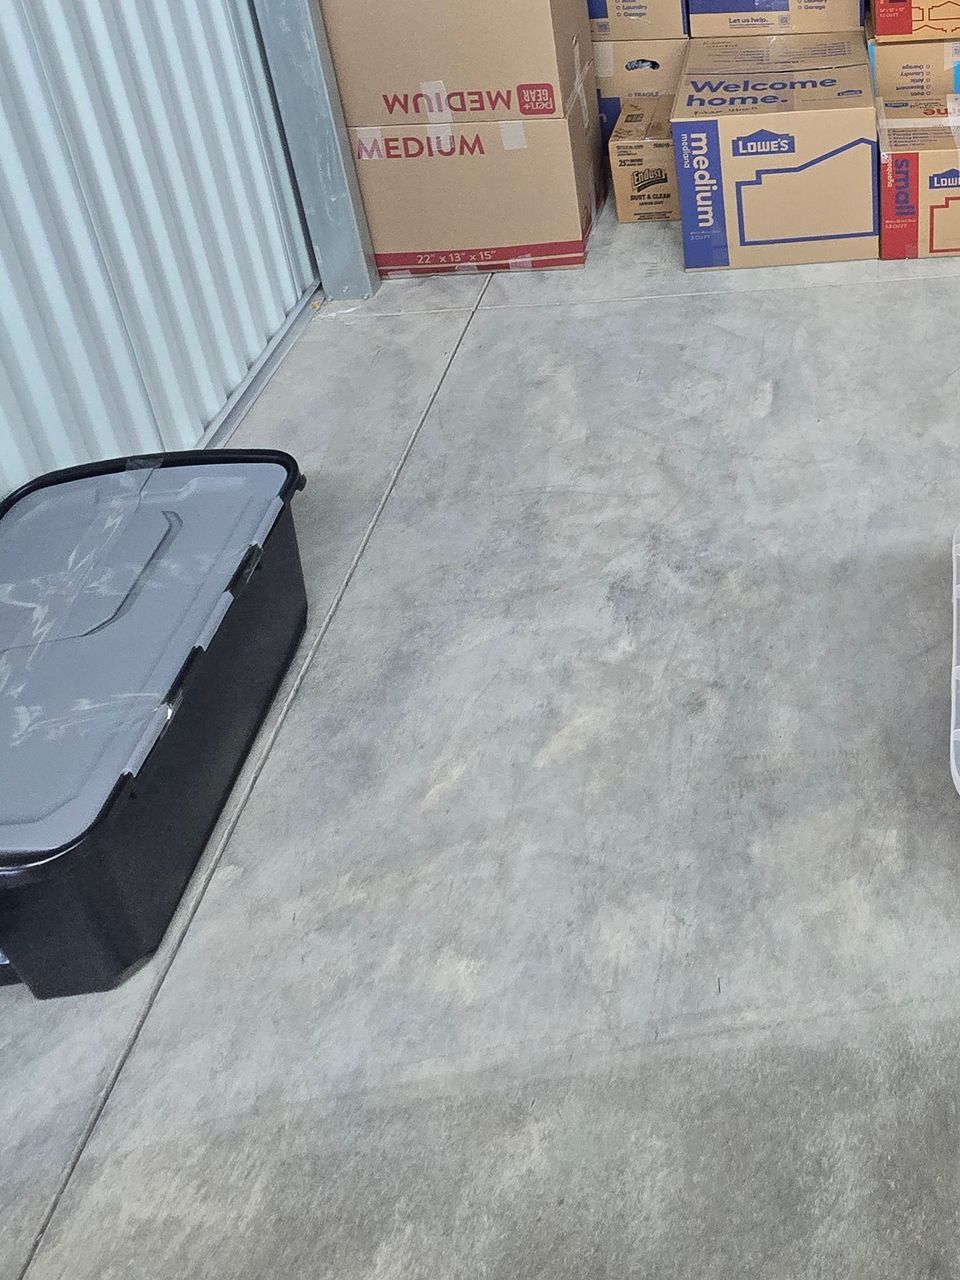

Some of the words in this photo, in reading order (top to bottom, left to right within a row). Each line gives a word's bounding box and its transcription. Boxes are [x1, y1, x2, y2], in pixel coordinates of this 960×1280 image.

[690, 78, 837, 93] Welcome
[382, 89, 511, 115] MEDIUM
[522, 88, 549, 101] GEAR
[686, 95, 788, 107] home.
[523, 99, 553, 110] pen+
[357, 133, 485, 159] MEDIUM
[681, 133, 691, 169] mediana
[739, 138, 789, 154] LOWE'S
[691, 132, 719, 228] medium
[895, 157, 915, 217] small
[416, 254, 435, 264] 22"
[439, 255, 447, 263] x
[448, 253, 466, 263] 13"
[479, 251, 496, 260] 15"
